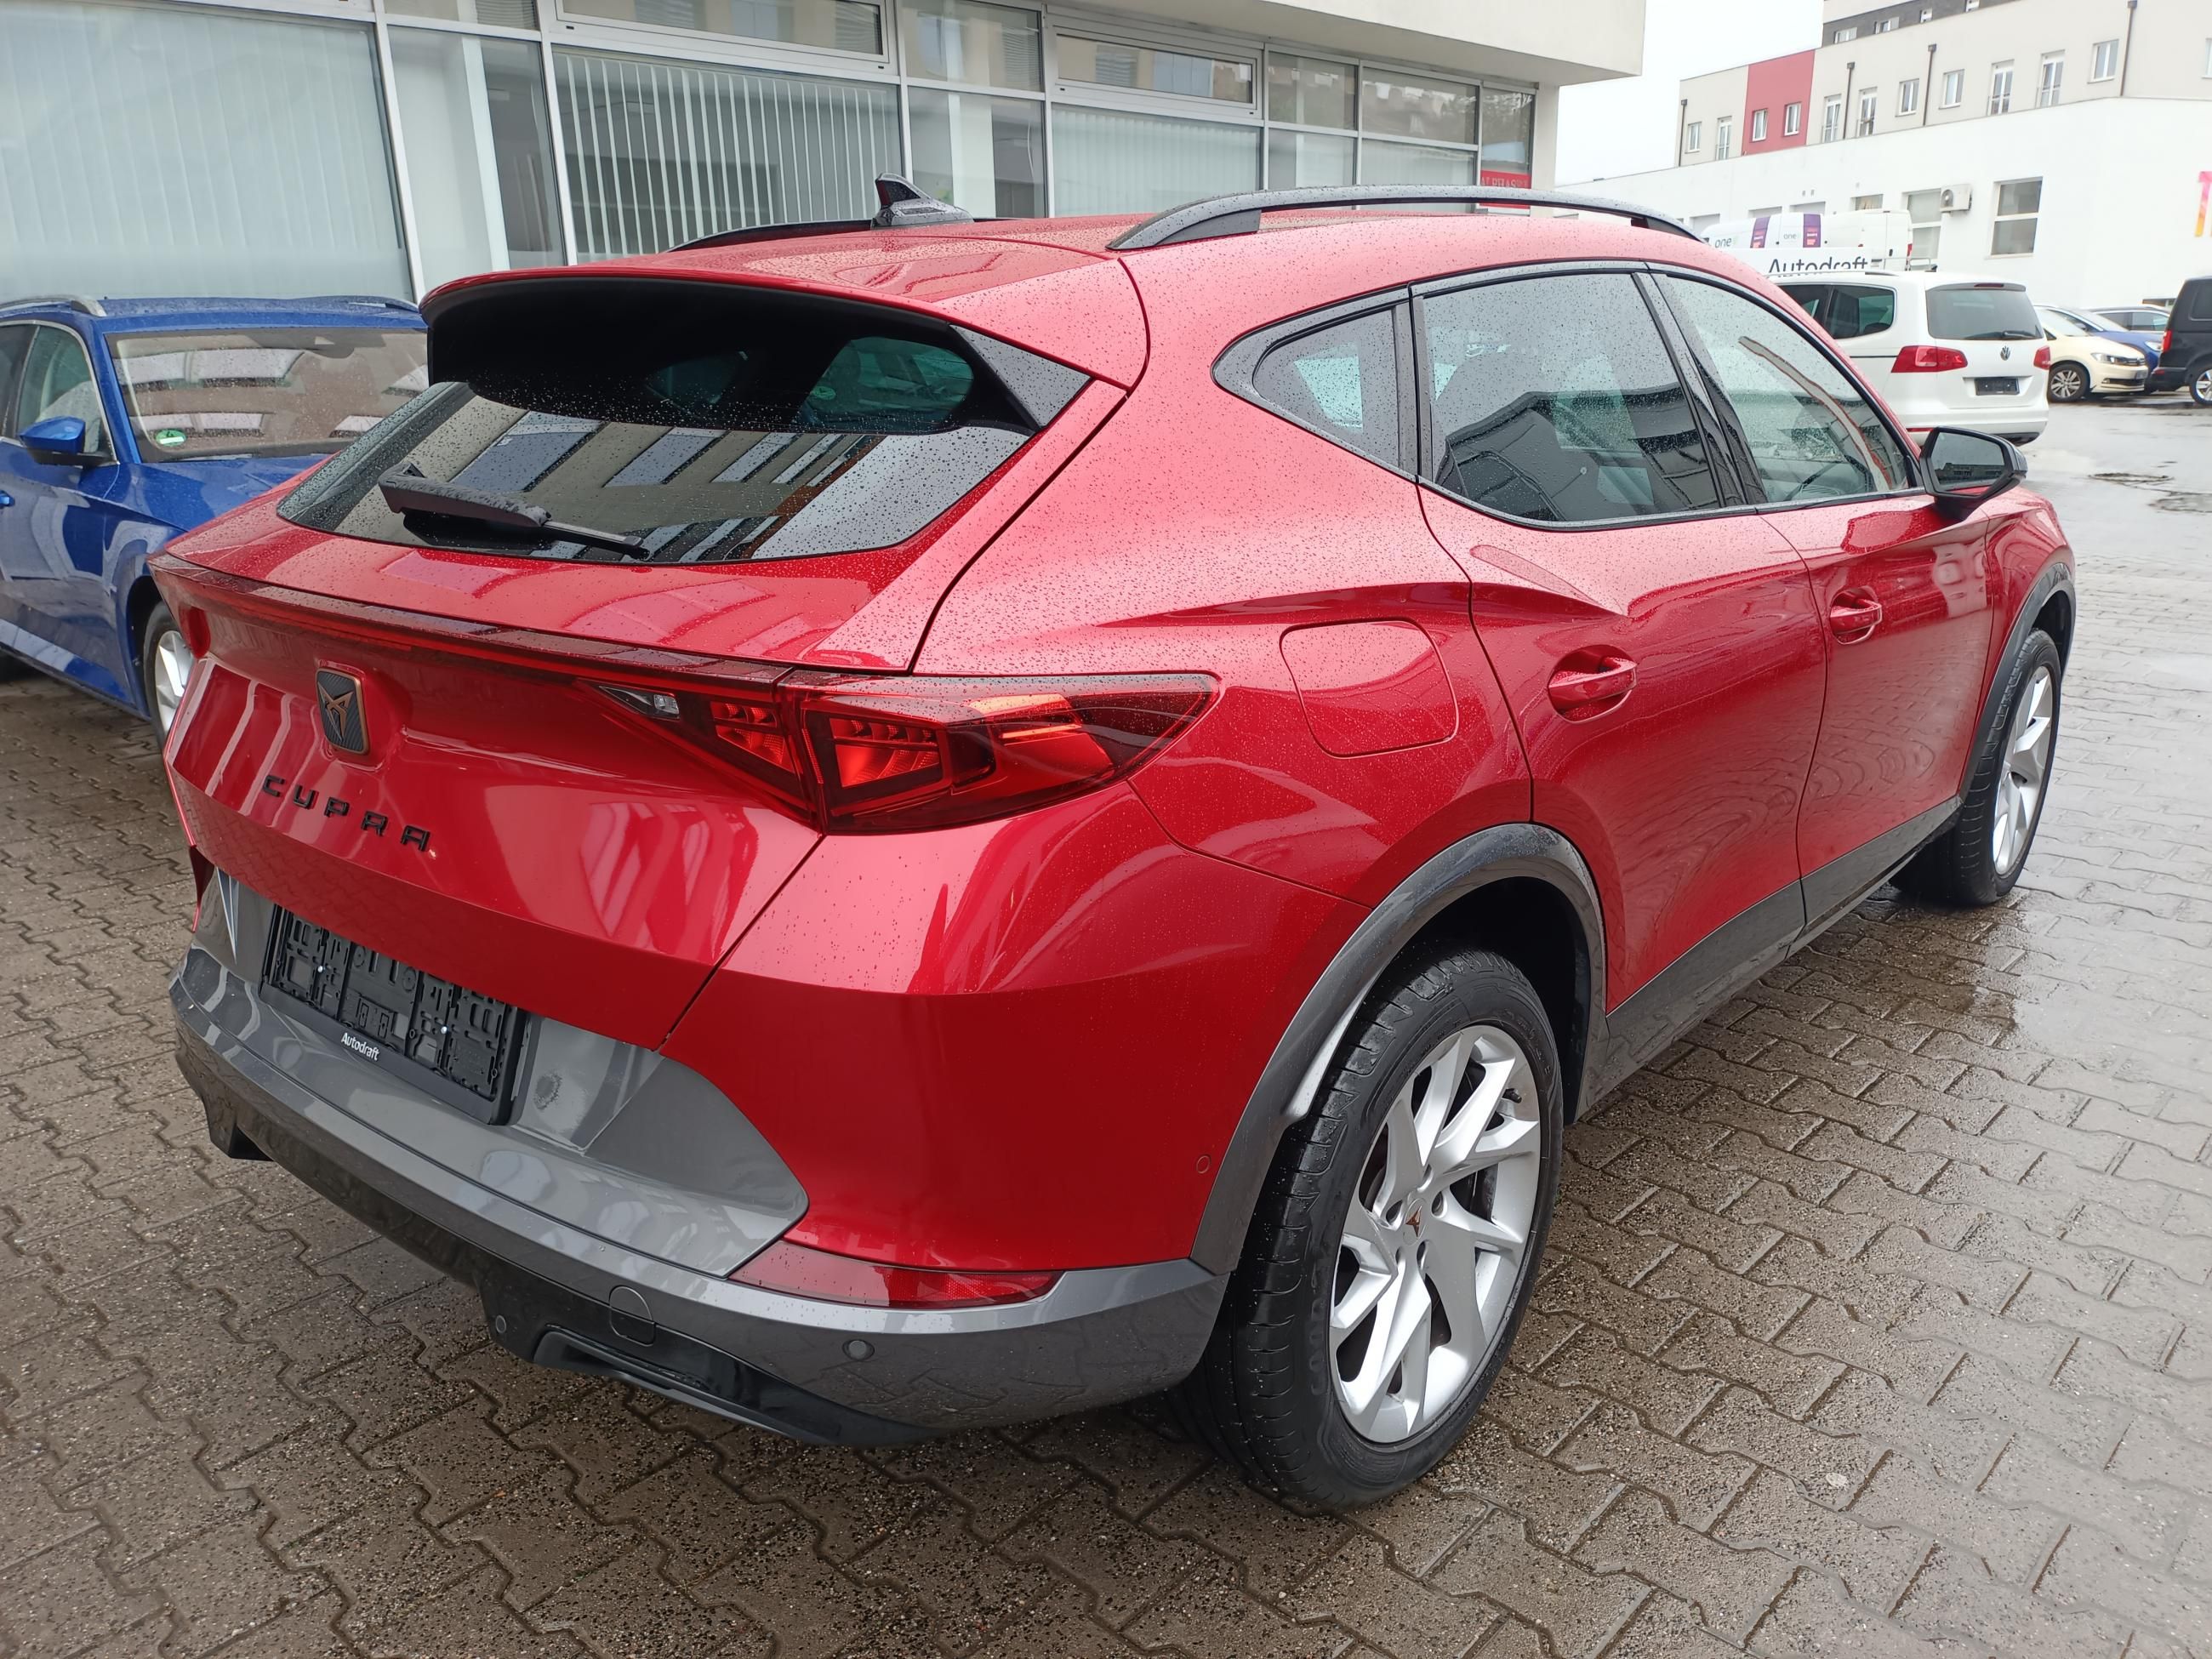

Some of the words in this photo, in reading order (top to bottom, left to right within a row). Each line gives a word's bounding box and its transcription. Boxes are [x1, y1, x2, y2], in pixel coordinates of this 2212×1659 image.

[1715, 237, 1732, 248] one
[1767, 256, 1868, 276] Autodraft
[263, 774, 430, 852] CUPRA
[340, 1032, 379, 1061] Autodraft
